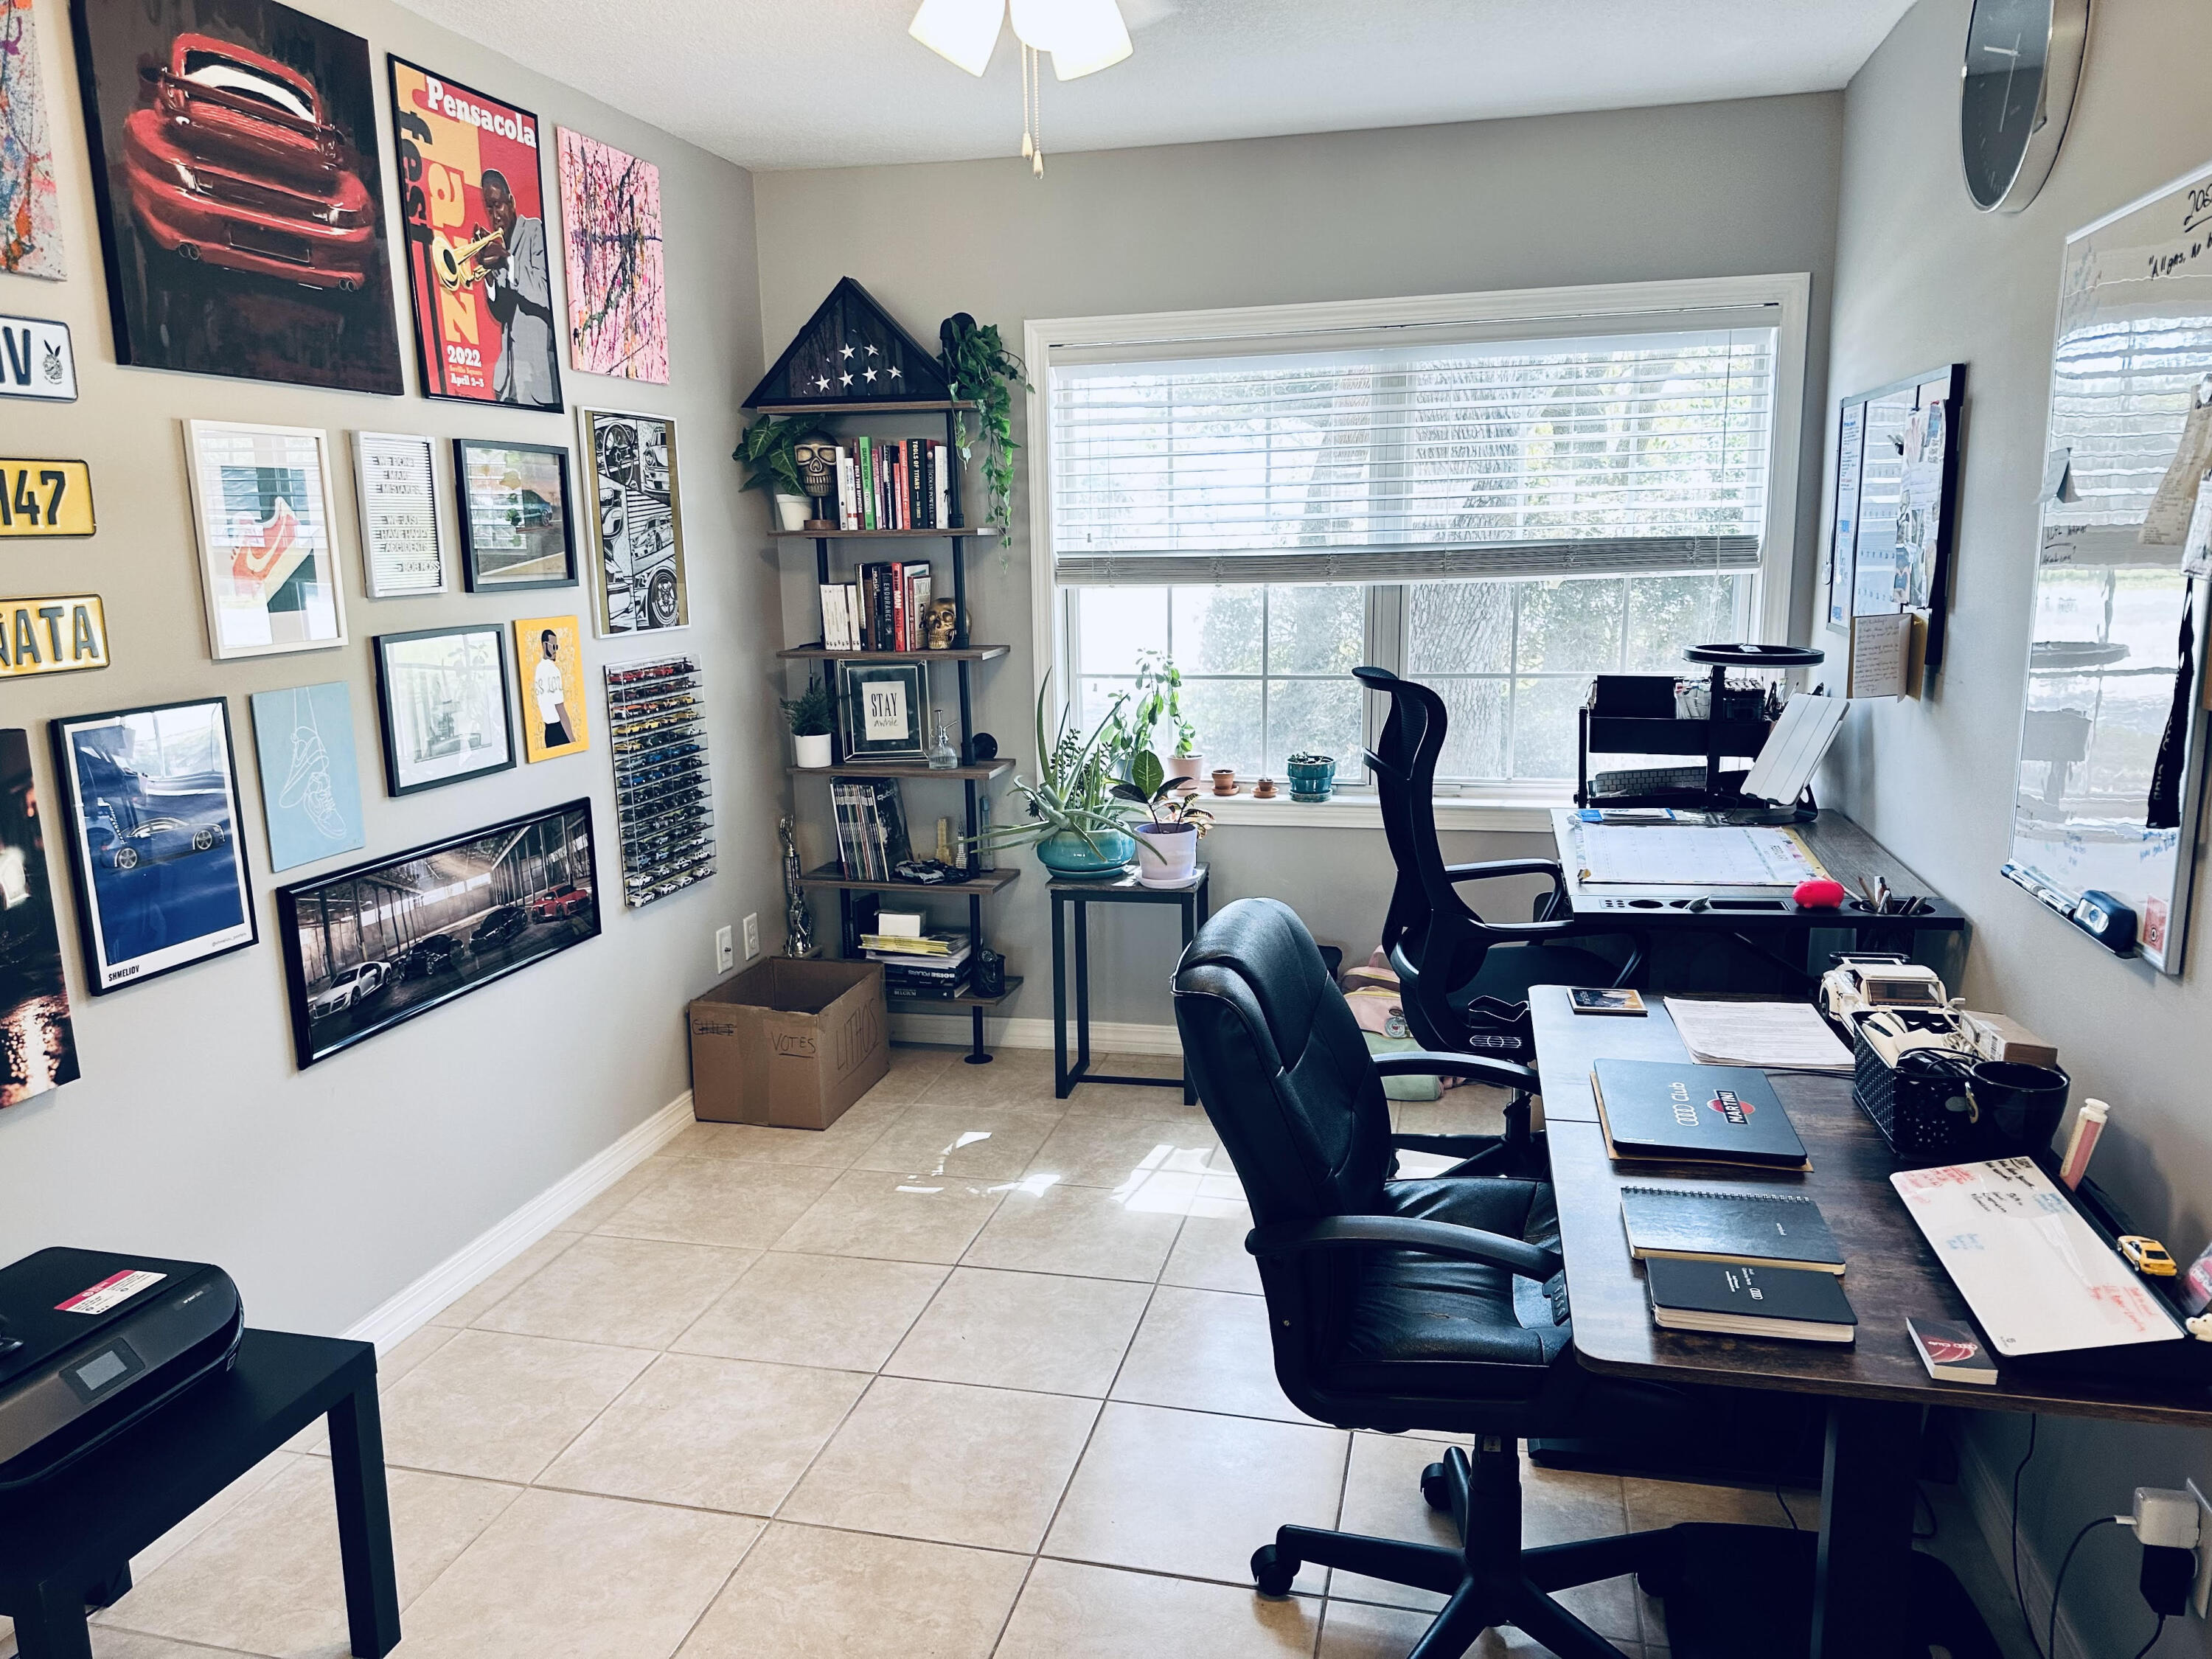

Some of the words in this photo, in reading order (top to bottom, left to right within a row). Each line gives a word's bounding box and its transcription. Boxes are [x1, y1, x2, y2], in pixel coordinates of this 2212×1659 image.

[425, 75, 536, 147] Pensacola
[0, 326, 31, 386] V
[447, 344, 482, 368] 2022
[451, 372, 470, 386] April
[914, 460, 919, 468] OF
[871, 693, 897, 717] STAY
[108, 965, 140, 981] SHMELIOV
[908, 970, 931, 978] POLARIS
[771, 1032, 816, 1054] VOTES
[835, 998, 878, 1071] LITHOS
[1668, 1082, 1690, 1102] Club
[1719, 1091, 1745, 1123] MARTINI
